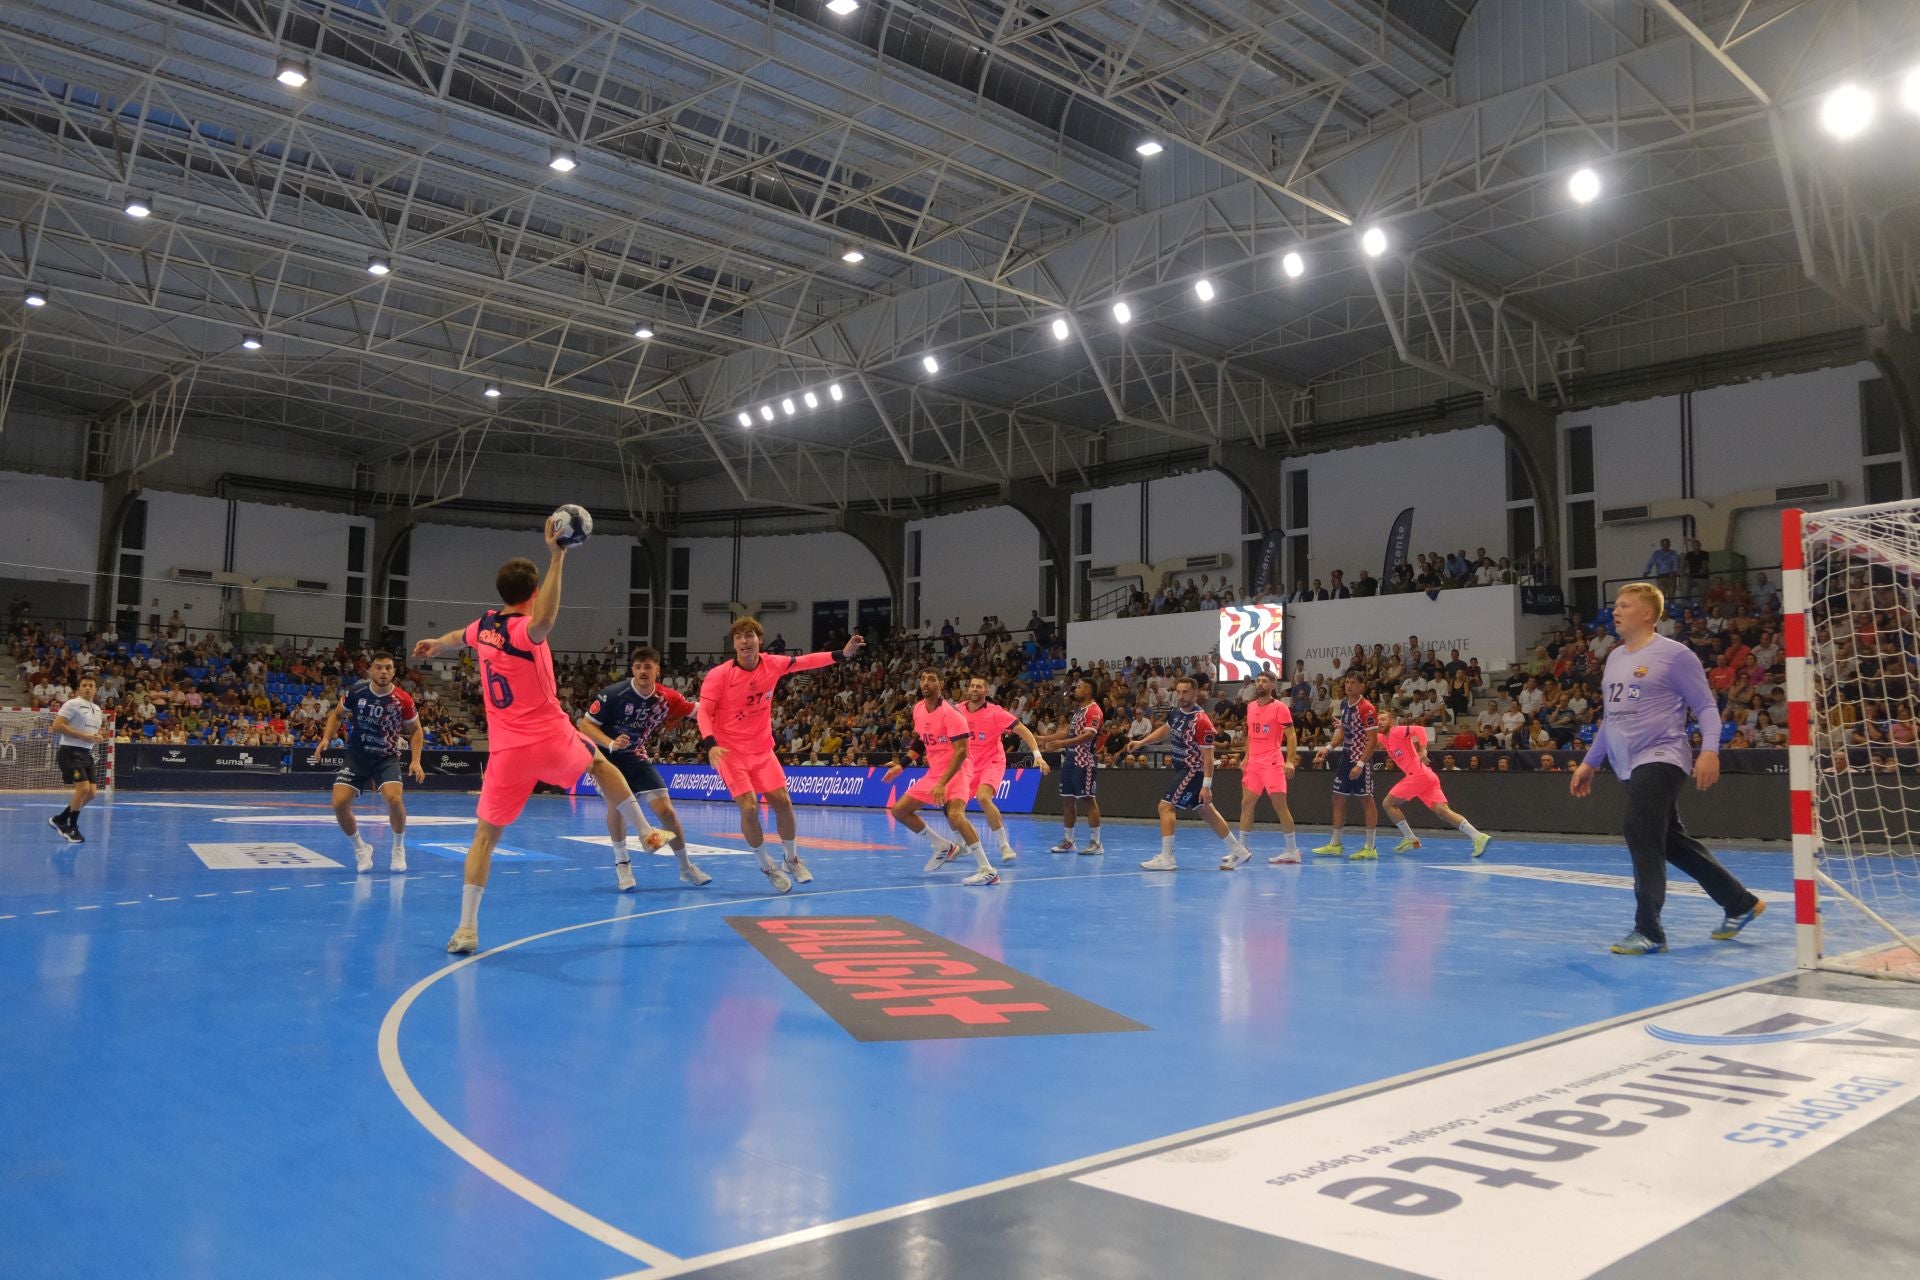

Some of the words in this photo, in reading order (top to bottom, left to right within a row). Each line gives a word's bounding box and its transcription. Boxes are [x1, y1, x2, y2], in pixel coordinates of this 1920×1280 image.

[1609, 682, 1624, 702] 12
[635, 708, 651, 720] 15
[923, 733, 937, 746] 45
[216, 758, 244, 766] suma
[786, 770, 864, 801] exusenergia.com
[756, 918, 1051, 1025] LALIGA+
[1487, 1093, 1553, 1115] Alicante
[1724, 1075, 1906, 1149] DEPORTES
[1317, 1055, 1817, 1217] Alicante
[1361, 1144, 1393, 1155] de
[1265, 1154, 1370, 1187] Deportes
